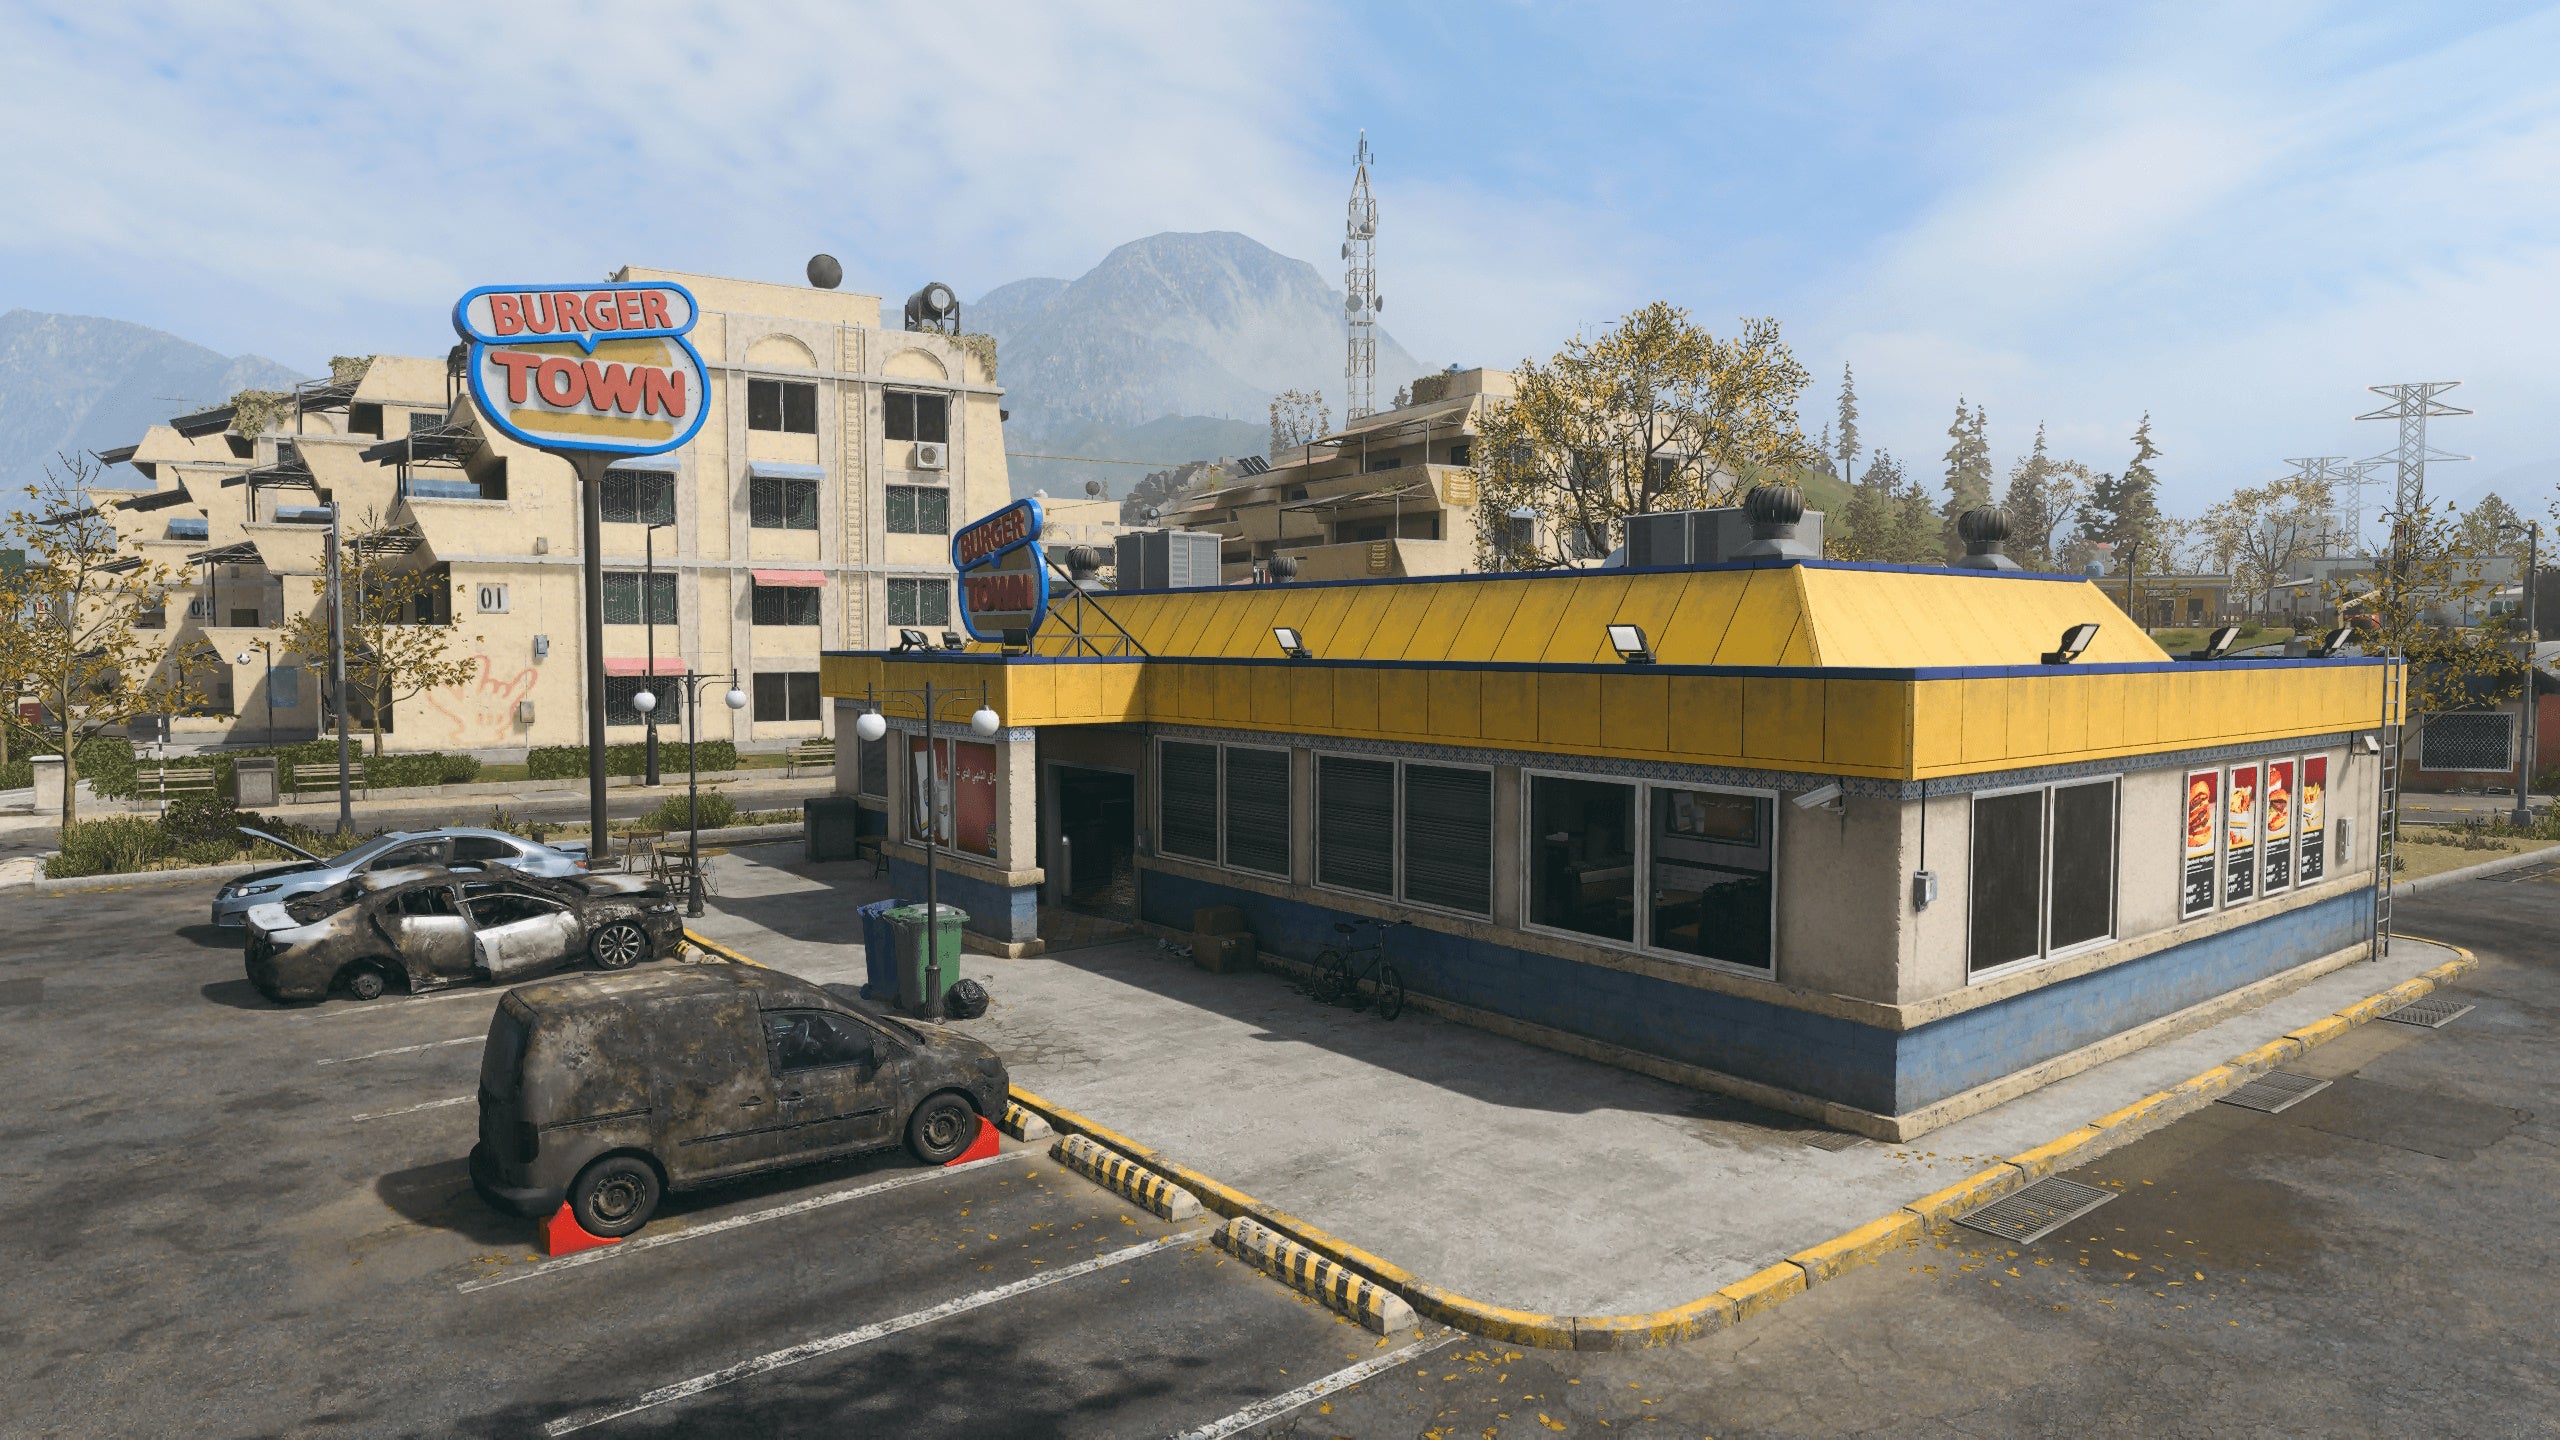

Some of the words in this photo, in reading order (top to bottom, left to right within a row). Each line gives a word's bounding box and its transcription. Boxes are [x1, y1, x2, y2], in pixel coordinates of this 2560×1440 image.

[489, 290, 673, 336] BURGER
[490, 351, 686, 418] TOWN
[960, 509, 1026, 564] BURGER
[480, 587, 502, 609] 01
[965, 574, 1035, 613] TOWN
